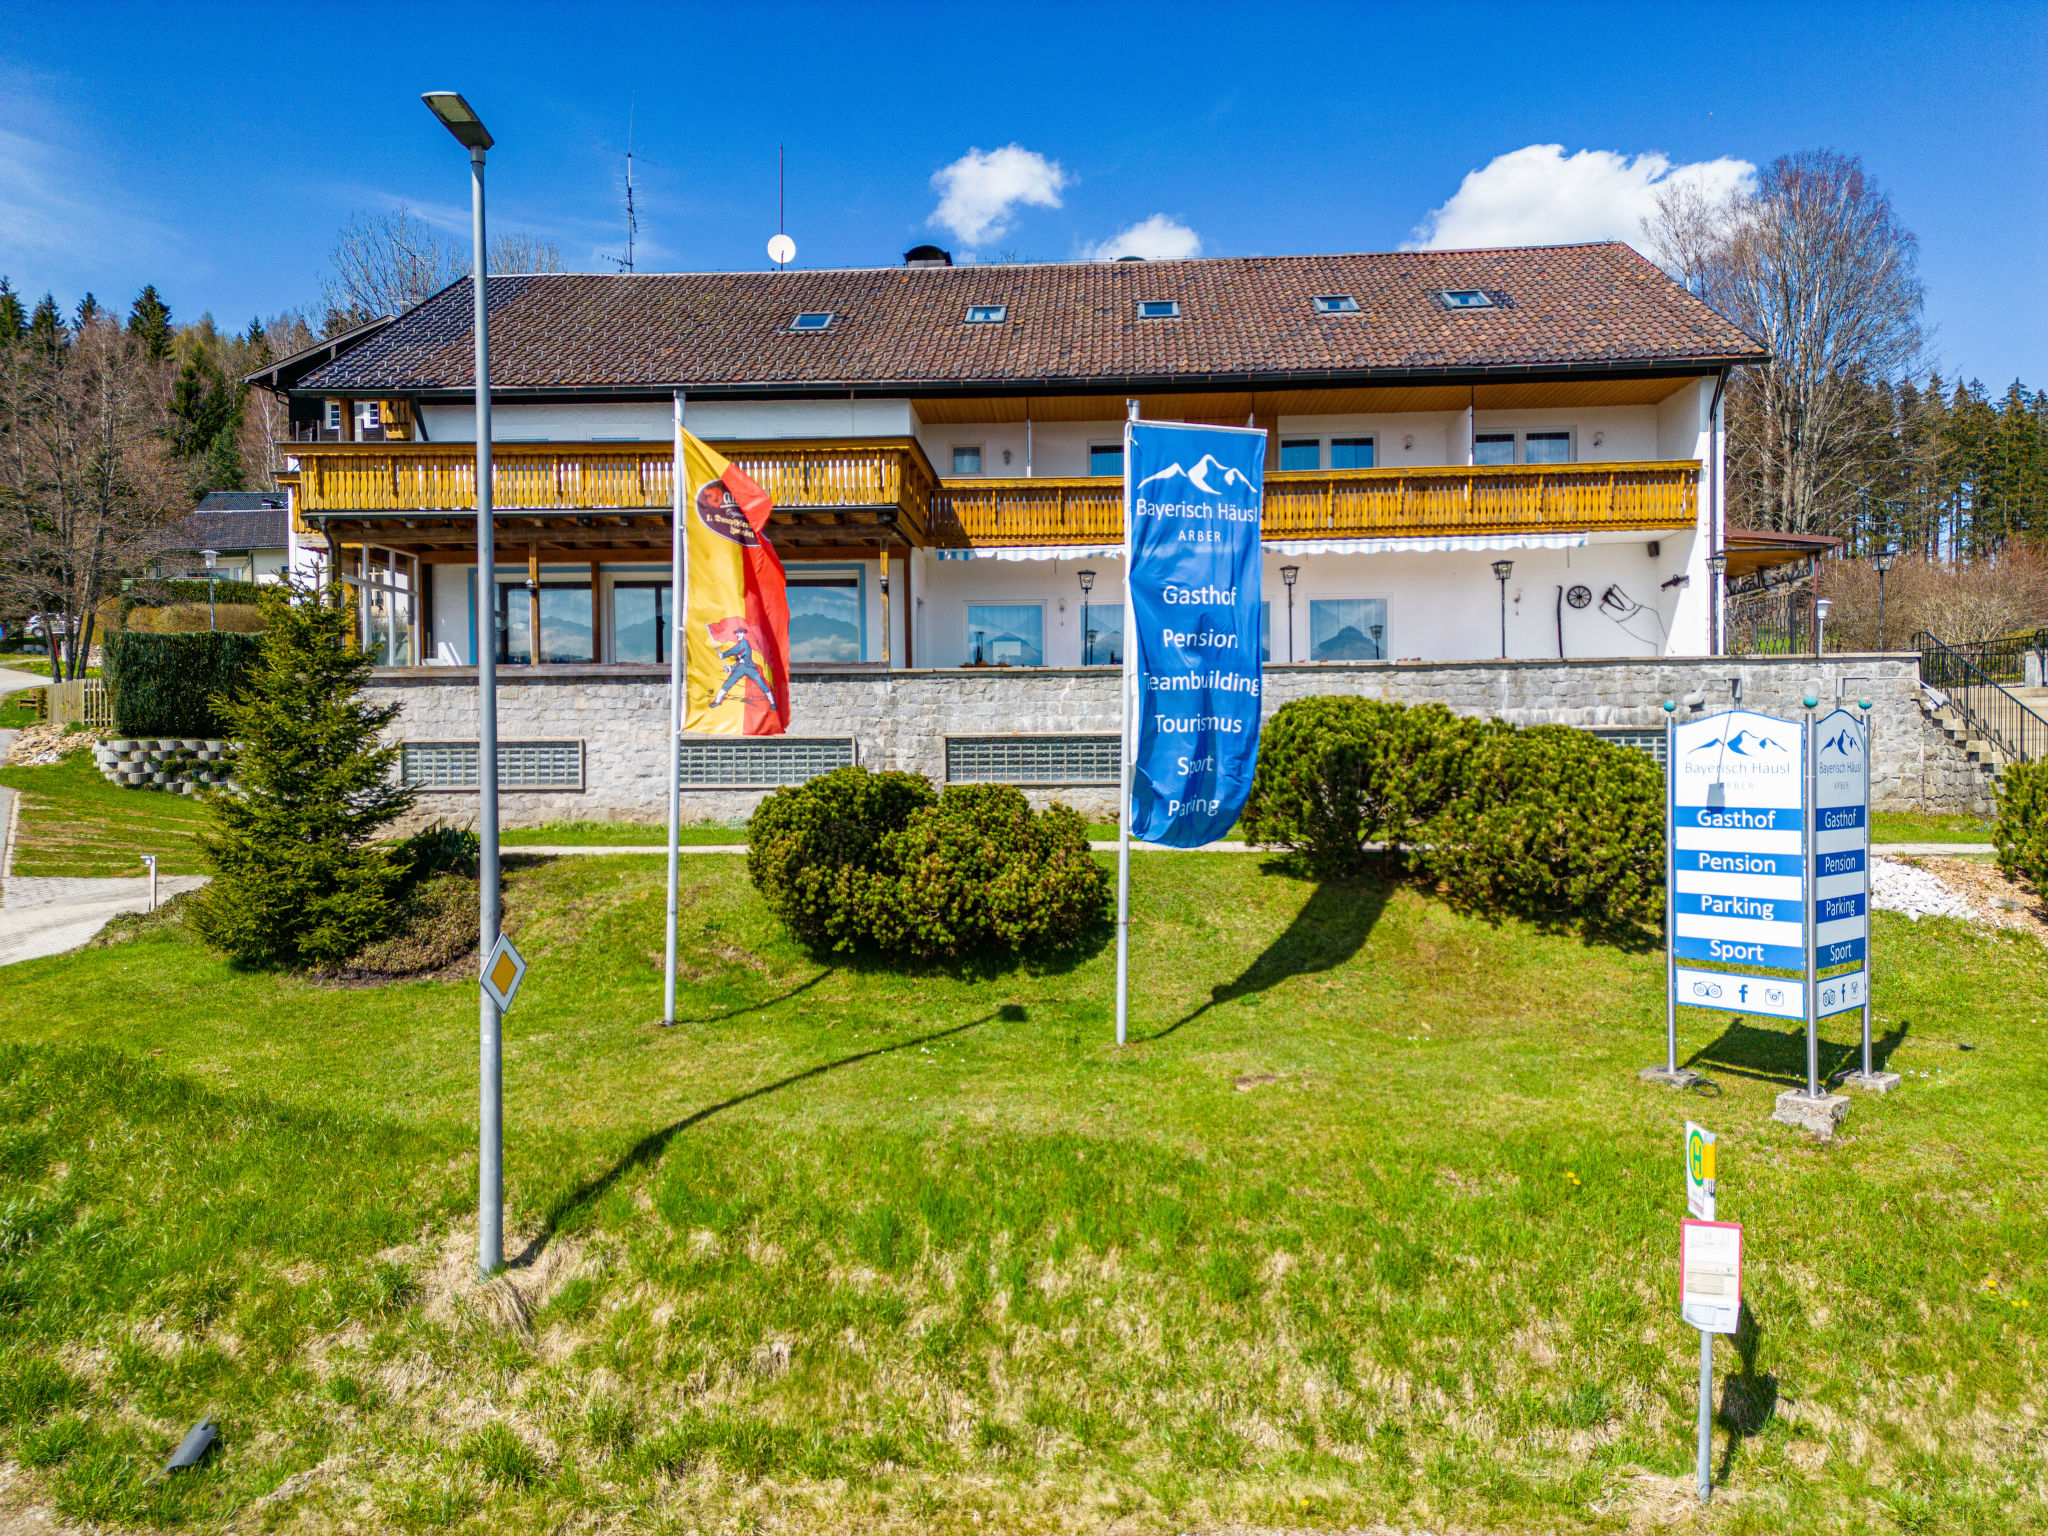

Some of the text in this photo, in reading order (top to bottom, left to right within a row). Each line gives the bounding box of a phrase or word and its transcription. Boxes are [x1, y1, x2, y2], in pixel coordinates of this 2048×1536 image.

[1136, 498, 1258, 523] Bayerisch Häusl
[1178, 530, 1221, 542] ARBER
[1163, 585, 1237, 606] Gasthof
[1163, 629, 1238, 649] Pension
[1144, 670, 1260, 697] Teambuilding
[1155, 714, 1242, 733] Tourismus
[1177, 755, 1214, 779] Sport
[1685, 762, 1790, 777] Bayerisch Häusl
[1819, 761, 1862, 777] Bayerisch Häusl
[1719, 782, 1755, 790] ARBER
[1834, 781, 1849, 790] ARBER
[1697, 809, 1777, 829] Gasthof
[1825, 808, 1857, 829] Gasthof
[1698, 852, 1776, 874] Pension
[1825, 854, 1856, 873] Pension
[1701, 895, 1774, 921] Parking
[1826, 897, 1855, 917] Parking
[1710, 939, 1765, 962] Sport
[1830, 942, 1852, 965] Sport
[1693, 1141, 1702, 1174] H
